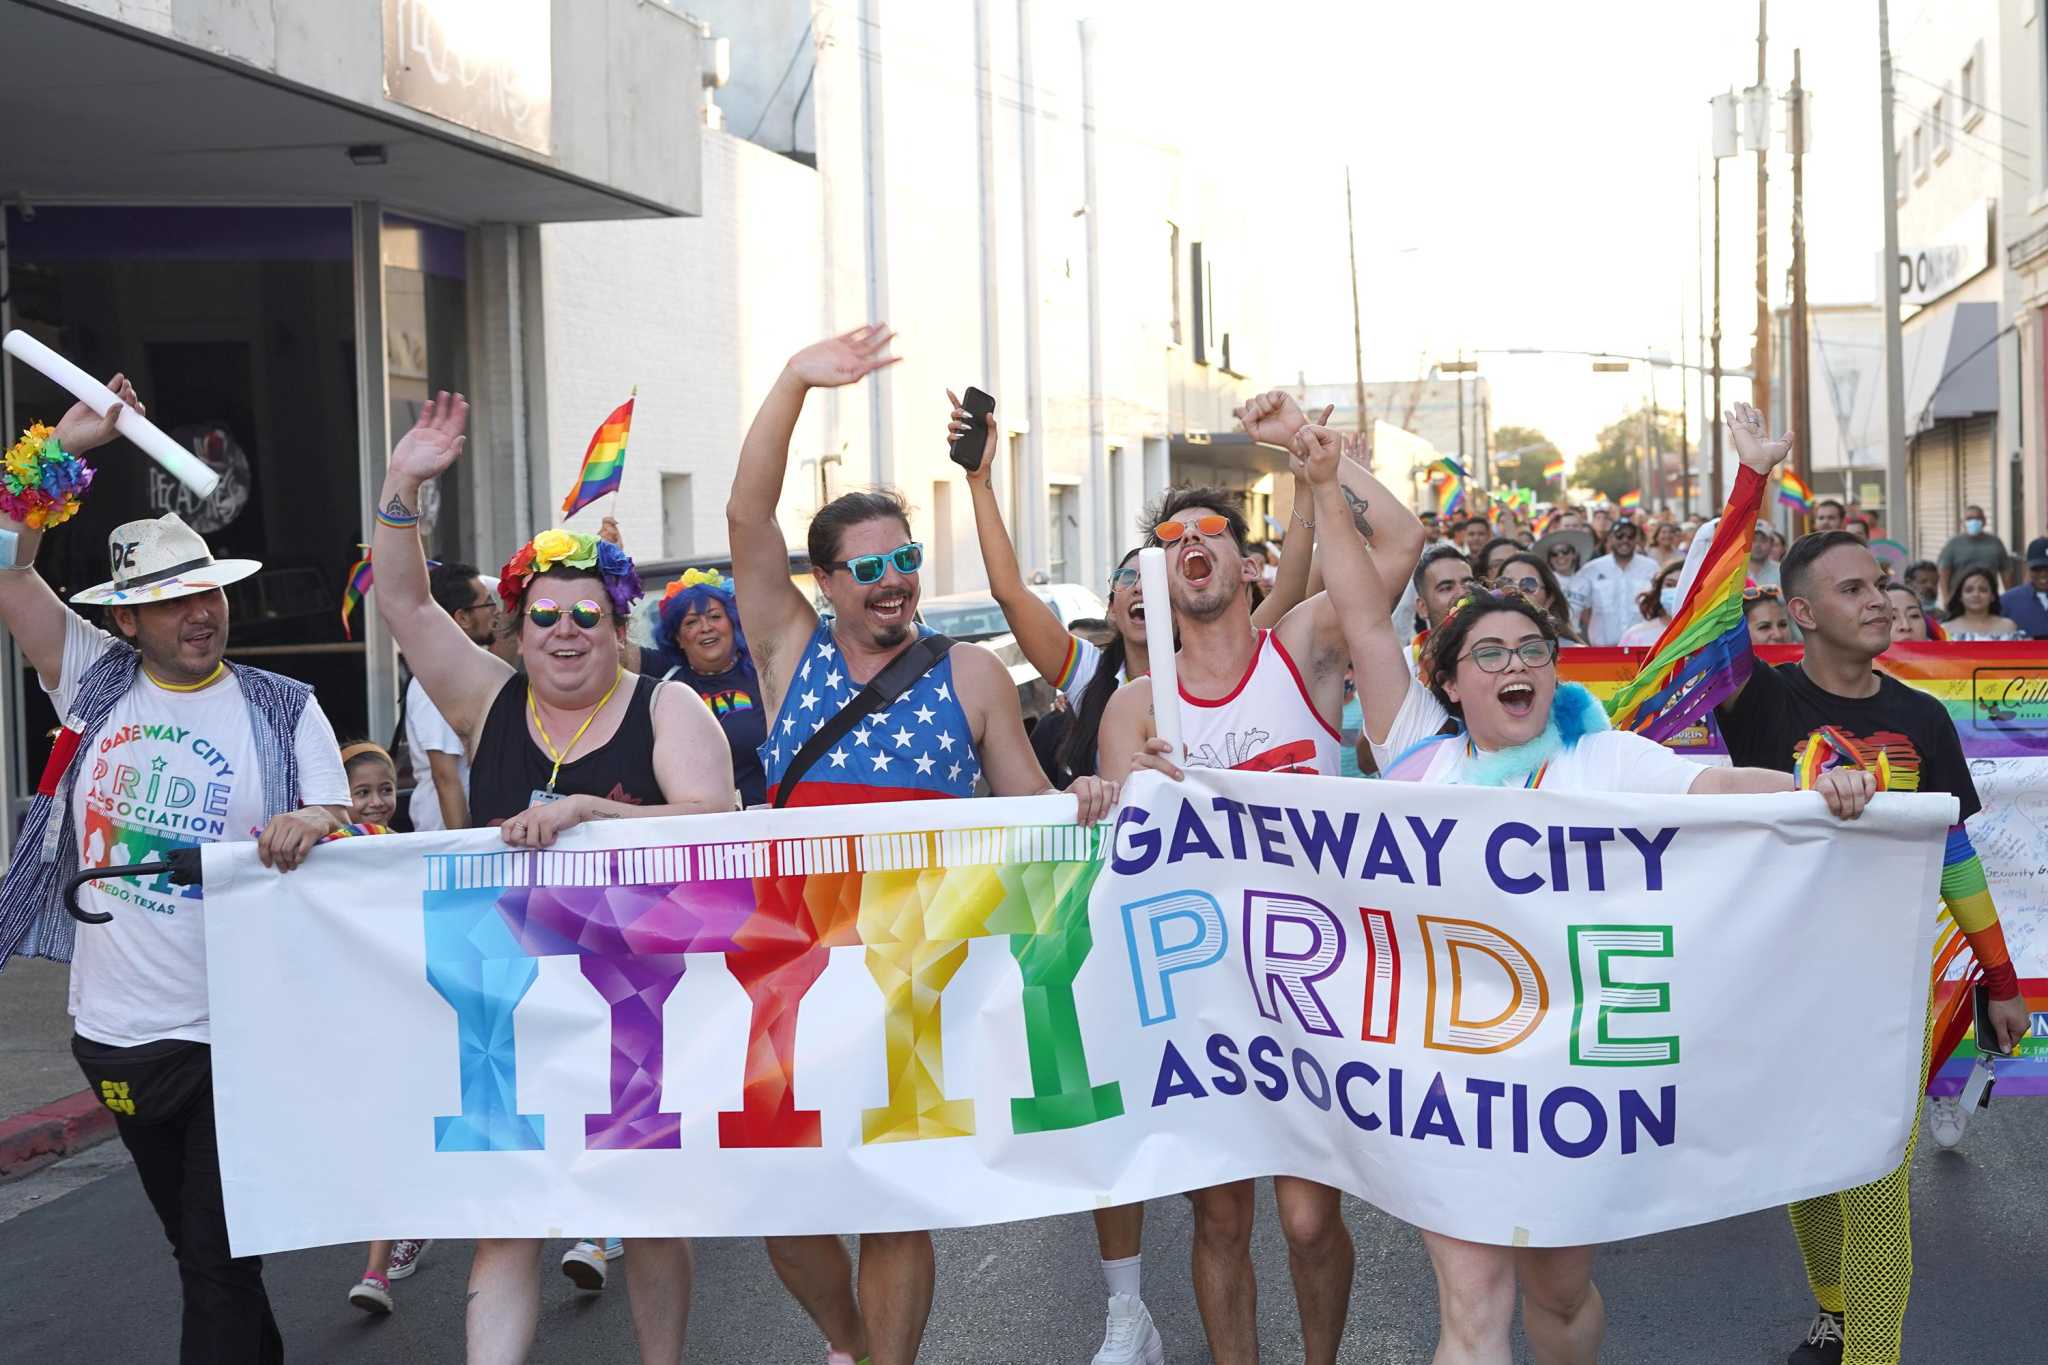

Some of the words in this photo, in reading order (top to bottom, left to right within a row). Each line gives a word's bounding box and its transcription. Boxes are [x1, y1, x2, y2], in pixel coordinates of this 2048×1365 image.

[100, 724, 190, 754] GATEWAY
[191, 739, 234, 778] CITY
[1110, 797, 1458, 887] GATEWAY
[1485, 821, 1680, 895] CITY
[88, 878, 130, 903] AREDO,
[134, 894, 175, 915] TEXAS
[1120, 889, 1681, 1068] PRIDE
[1151, 1033, 1677, 1159] ASSOCIATION
